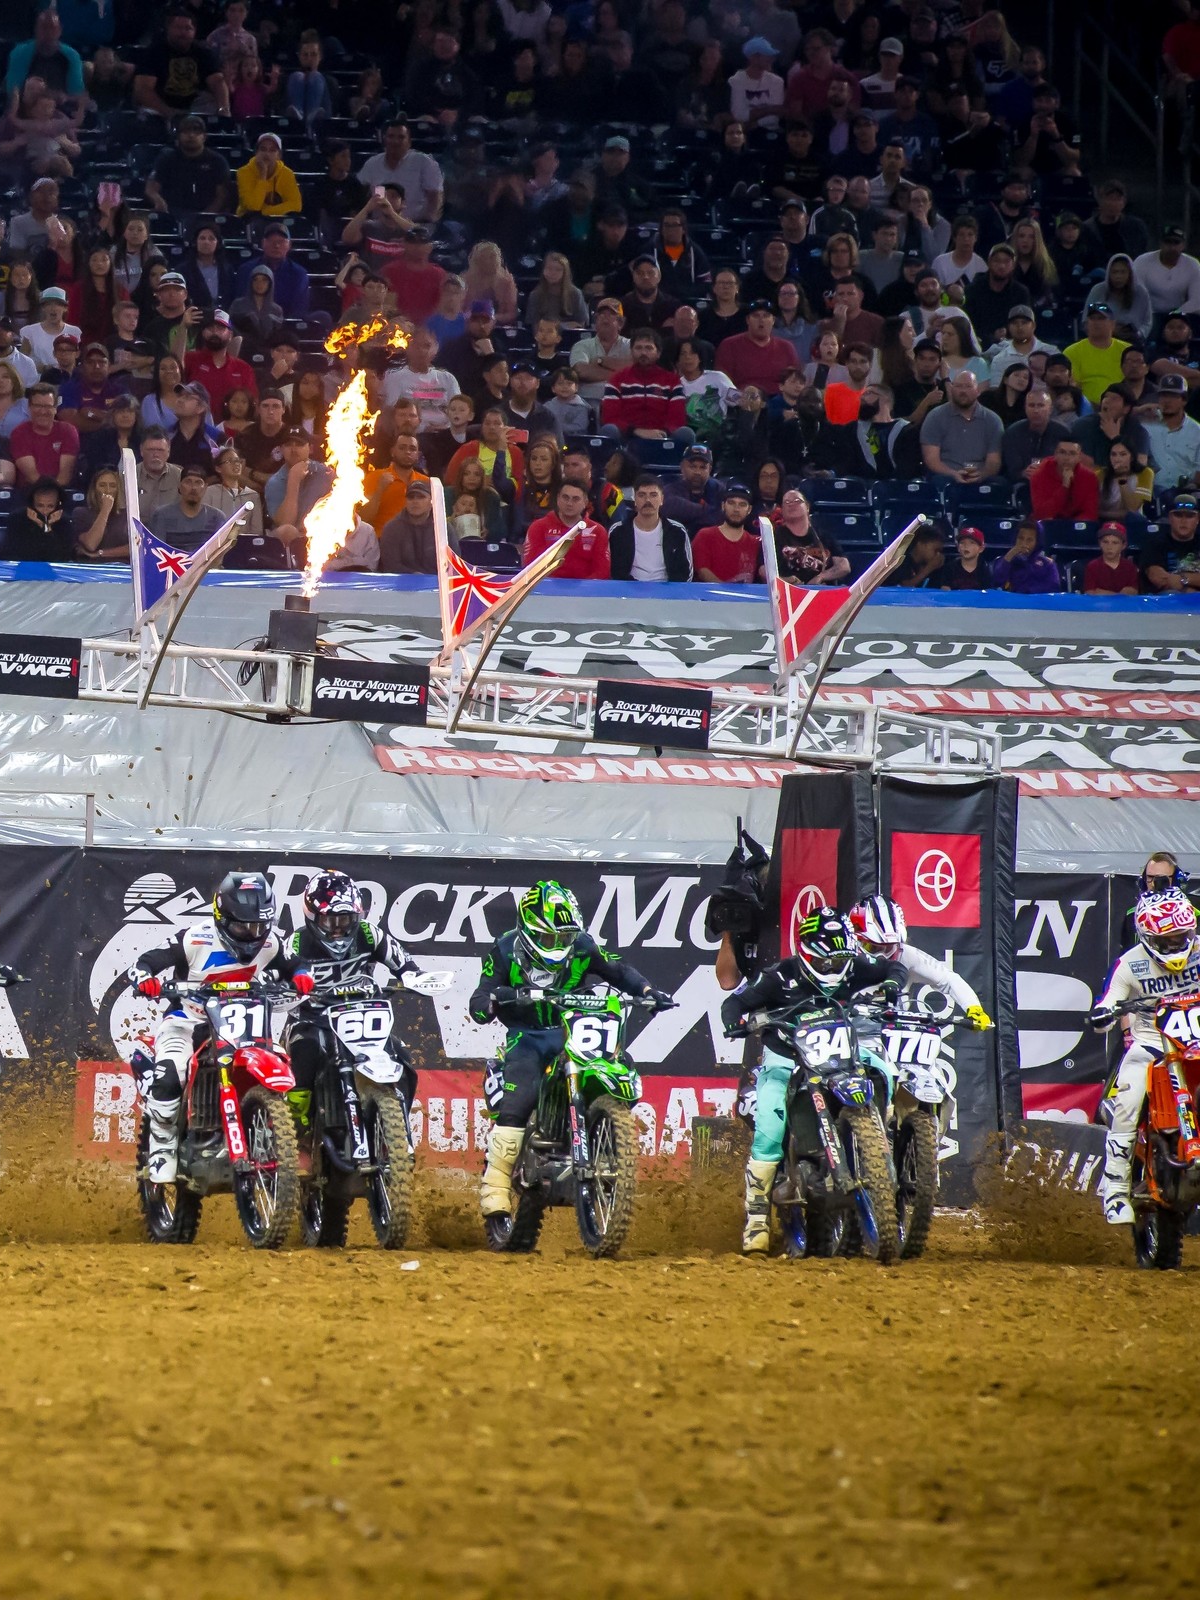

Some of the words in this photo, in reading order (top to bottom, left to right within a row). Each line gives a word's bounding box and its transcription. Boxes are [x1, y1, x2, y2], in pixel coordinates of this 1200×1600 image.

[16, 653, 71, 665] MOUNTAIN
[332, 678, 365, 688] ROCKY
[366, 680, 420, 692] MOUNTAIN
[615, 700, 648, 712] ROCKY
[648, 704, 702, 717] MOUNTAIN
[262, 865, 530, 944] ROCK
[1138, 973, 1174, 994] TROY
[219, 1004, 265, 1039] 31
[337, 1010, 391, 1043] 60
[572, 1016, 620, 1051] 61
[805, 1026, 852, 1066] 34
[887, 1029, 941, 1065] 170
[223, 1098, 244, 1155] GICO
